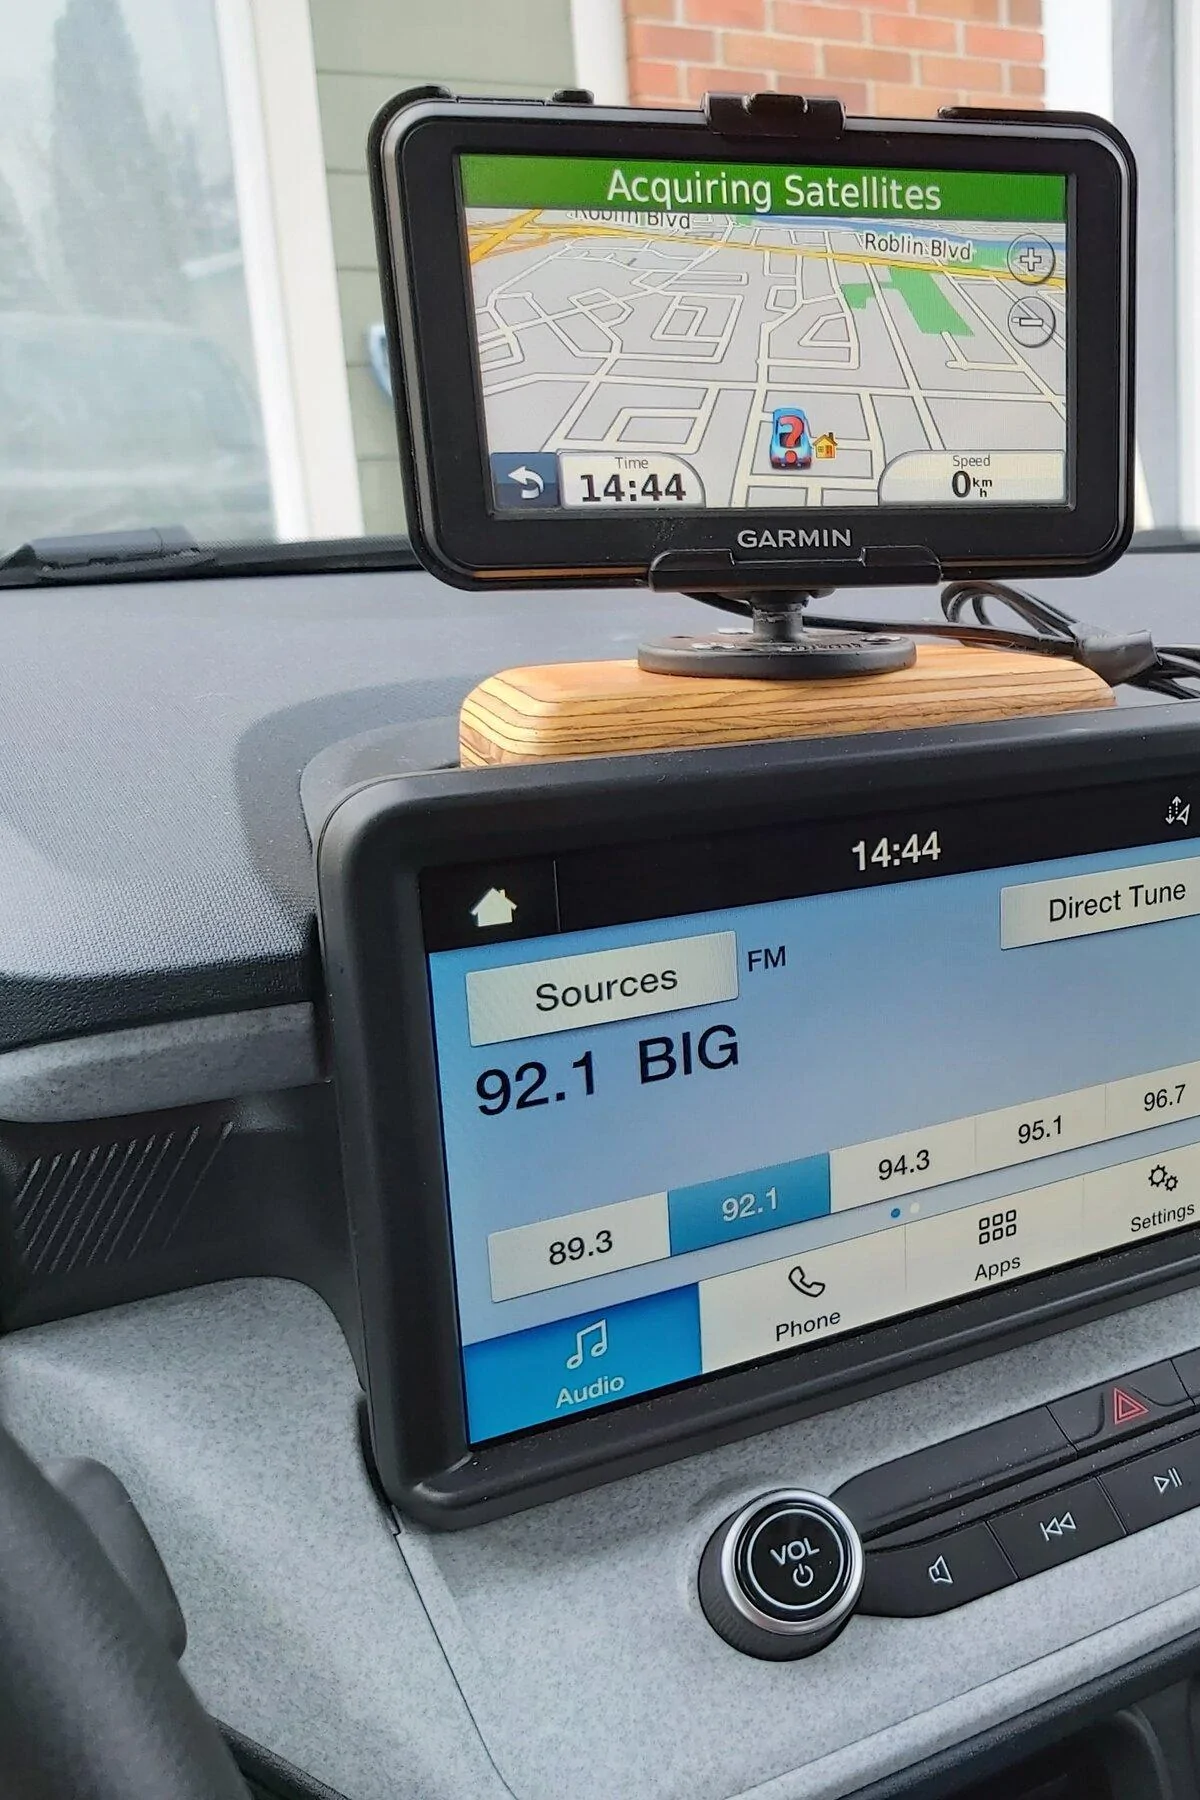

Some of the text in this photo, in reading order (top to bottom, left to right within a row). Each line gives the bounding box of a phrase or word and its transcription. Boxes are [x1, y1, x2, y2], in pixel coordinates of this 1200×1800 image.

[605, 169, 942, 213] Acquiring Satellites
[647, 211, 691, 230] Blvd
[865, 232, 972, 261] Roblin Blvd
[614, 456, 649, 470] Time
[952, 454, 991, 470] Speed
[580, 473, 687, 503] 14:44
[737, 529, 851, 548] GARMIN
[851, 831, 942, 872] 14:44
[1048, 882, 1187, 923] Direct Tune
[747, 945, 787, 973] FM
[535, 968, 679, 1012] Sources
[475, 1023, 740, 1117] 92.1 BIG
[1143, 1083, 1187, 1113] 96.7
[1017, 1115, 1063, 1146] 95.1
[878, 1149, 931, 1181] 94.3
[722, 1186, 779, 1222] 92.1
[1130, 1202, 1195, 1234] Settings
[548, 1229, 613, 1266] 89.3
[974, 1255, 1021, 1282] Apps
[775, 1310, 841, 1342] Phone
[555, 1375, 625, 1409] Audio
[770, 1537, 820, 1565] VOL
